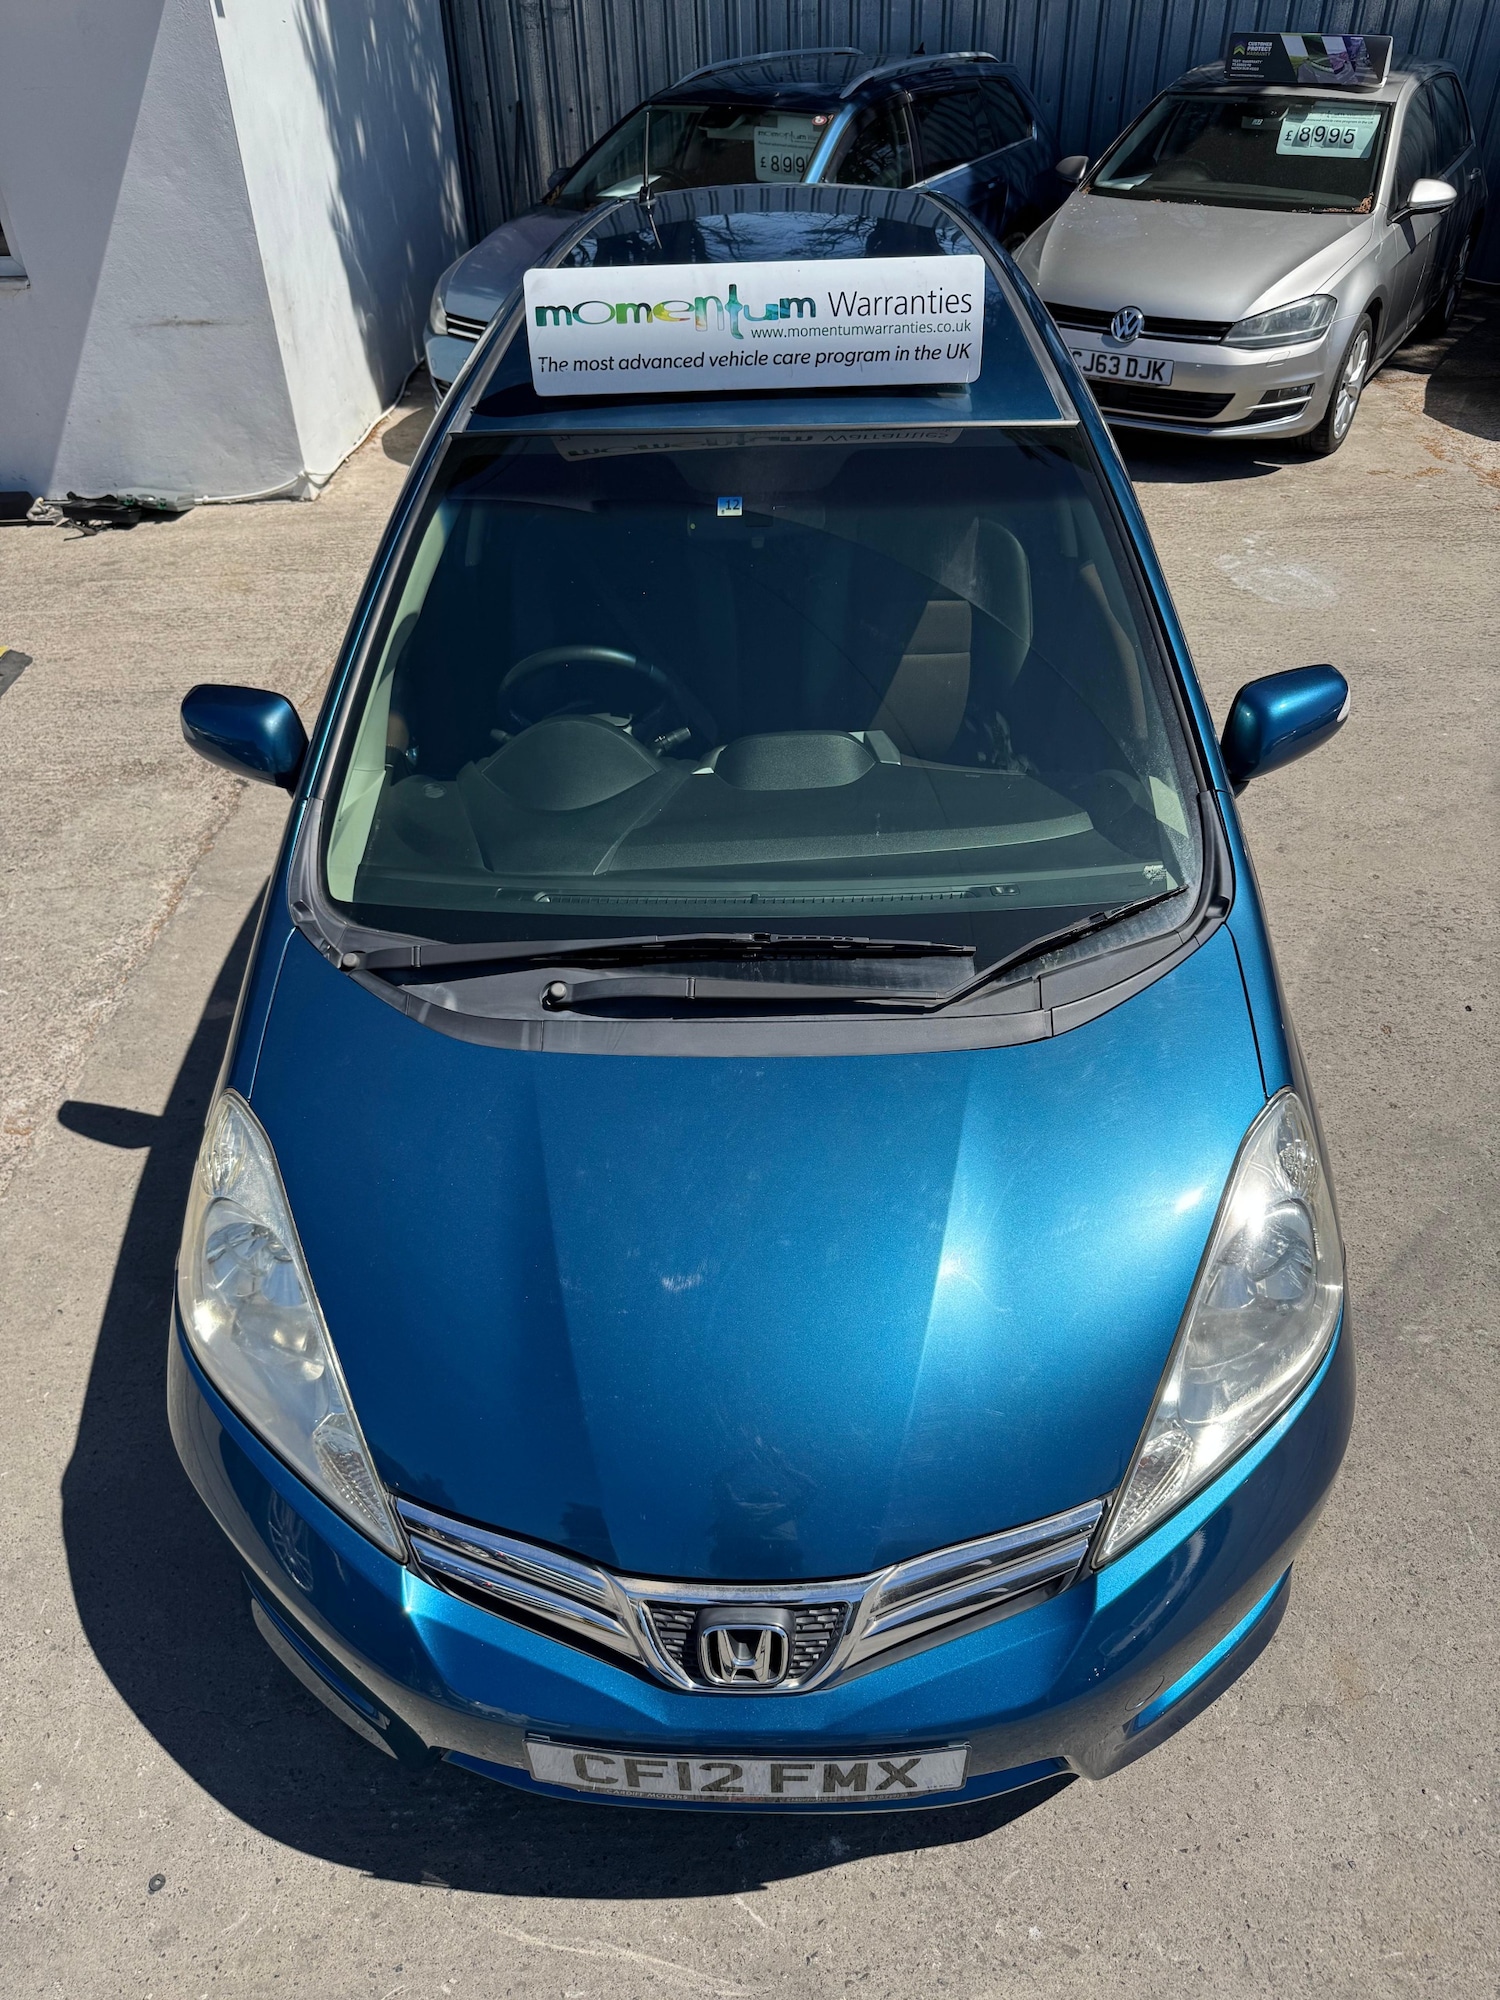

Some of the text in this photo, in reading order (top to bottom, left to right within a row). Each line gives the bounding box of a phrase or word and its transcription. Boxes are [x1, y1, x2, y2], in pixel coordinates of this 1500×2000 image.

[535, 283, 972, 341] momentum Warranties
[751, 319, 971, 339] www.momentumwarranties.co.uk
[538, 342, 972, 373] The most advanced vehicle care program in the UK
[1125, 358, 1166, 381] DJK
[725, 499, 741, 511] 12
[572, 1753, 922, 1793] CF12 FMX
[647, 1792, 688, 1801] MOTORS
